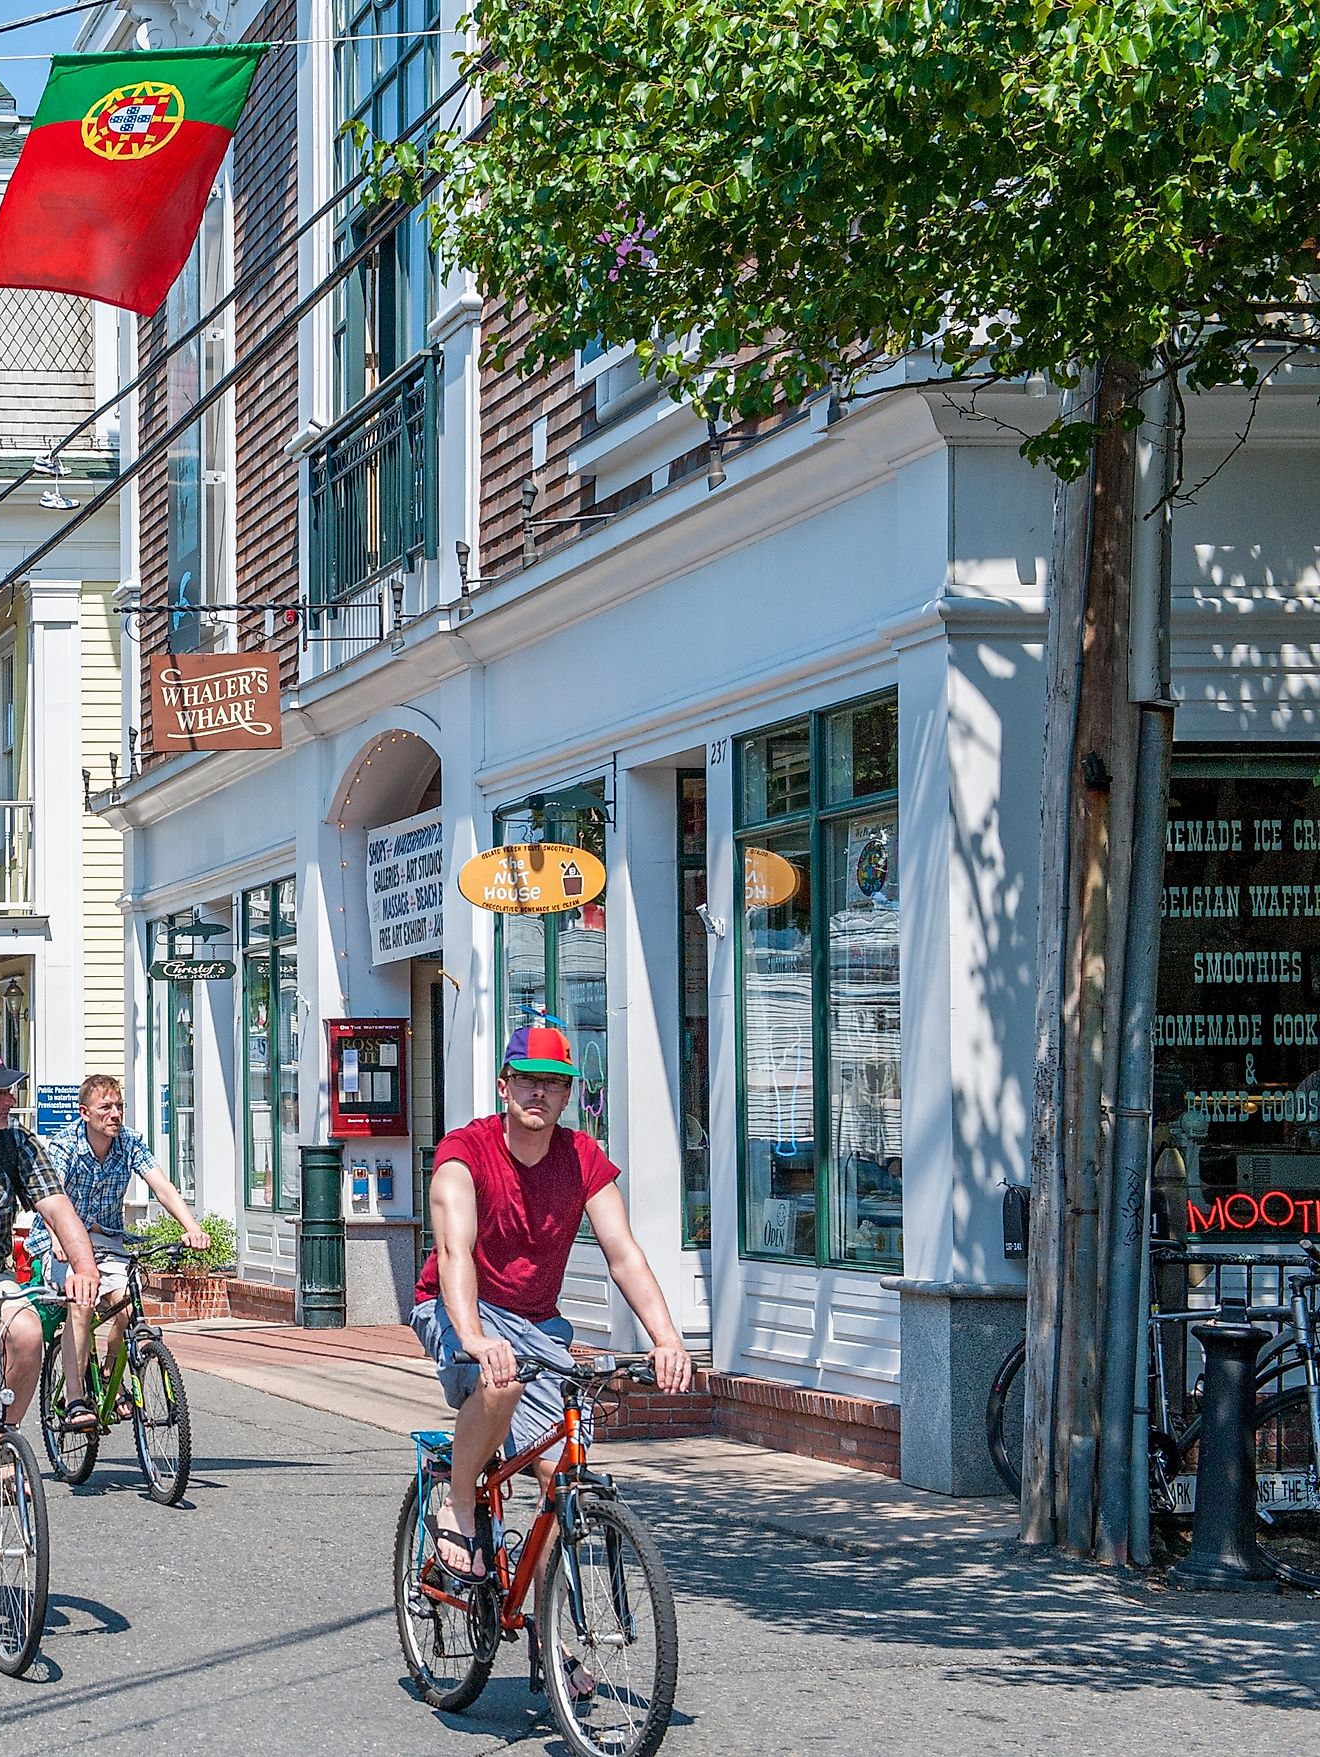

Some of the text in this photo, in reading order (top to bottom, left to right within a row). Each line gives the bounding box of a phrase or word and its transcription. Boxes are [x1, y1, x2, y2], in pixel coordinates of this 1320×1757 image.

[161, 671, 269, 707] WHALER'S
[175, 699, 257, 732] WHARF
[710, 739, 728, 766] 237
[393, 825, 436, 857] WATERFRONT
[1254, 819, 1282, 850] ICE
[482, 849, 501, 860] GELATO
[543, 845, 574, 854] SMOOTHIES
[499, 856, 525, 870] The
[374, 863, 400, 895] GALLERIES
[406, 857, 418, 883] ART
[494, 871, 530, 886] NUT
[382, 891, 410, 921] MASSAGE
[415, 882, 438, 912] BEACH
[562, 899, 580, 908] CREAM
[379, 927, 392, 952] FREE
[392, 924, 403, 948] ART
[404, 917, 428, 946] EXHIBIT
[159, 961, 226, 977] Christof's
[1194, 951, 1302, 983] SMOOTHIES
[1153, 1013, 1320, 1046] HOMEMADE COOK
[1246, 1053, 1257, 1084] &
[38, 1086, 53, 1094] Public
[1262, 1091, 1319, 1122] GOODS
[1187, 1191, 1320, 1233] MOOT
[764, 1220, 785, 1248] OPEN
[1170, 1481, 1191, 1505] ARK
[1282, 1479, 1303, 1502] THE
